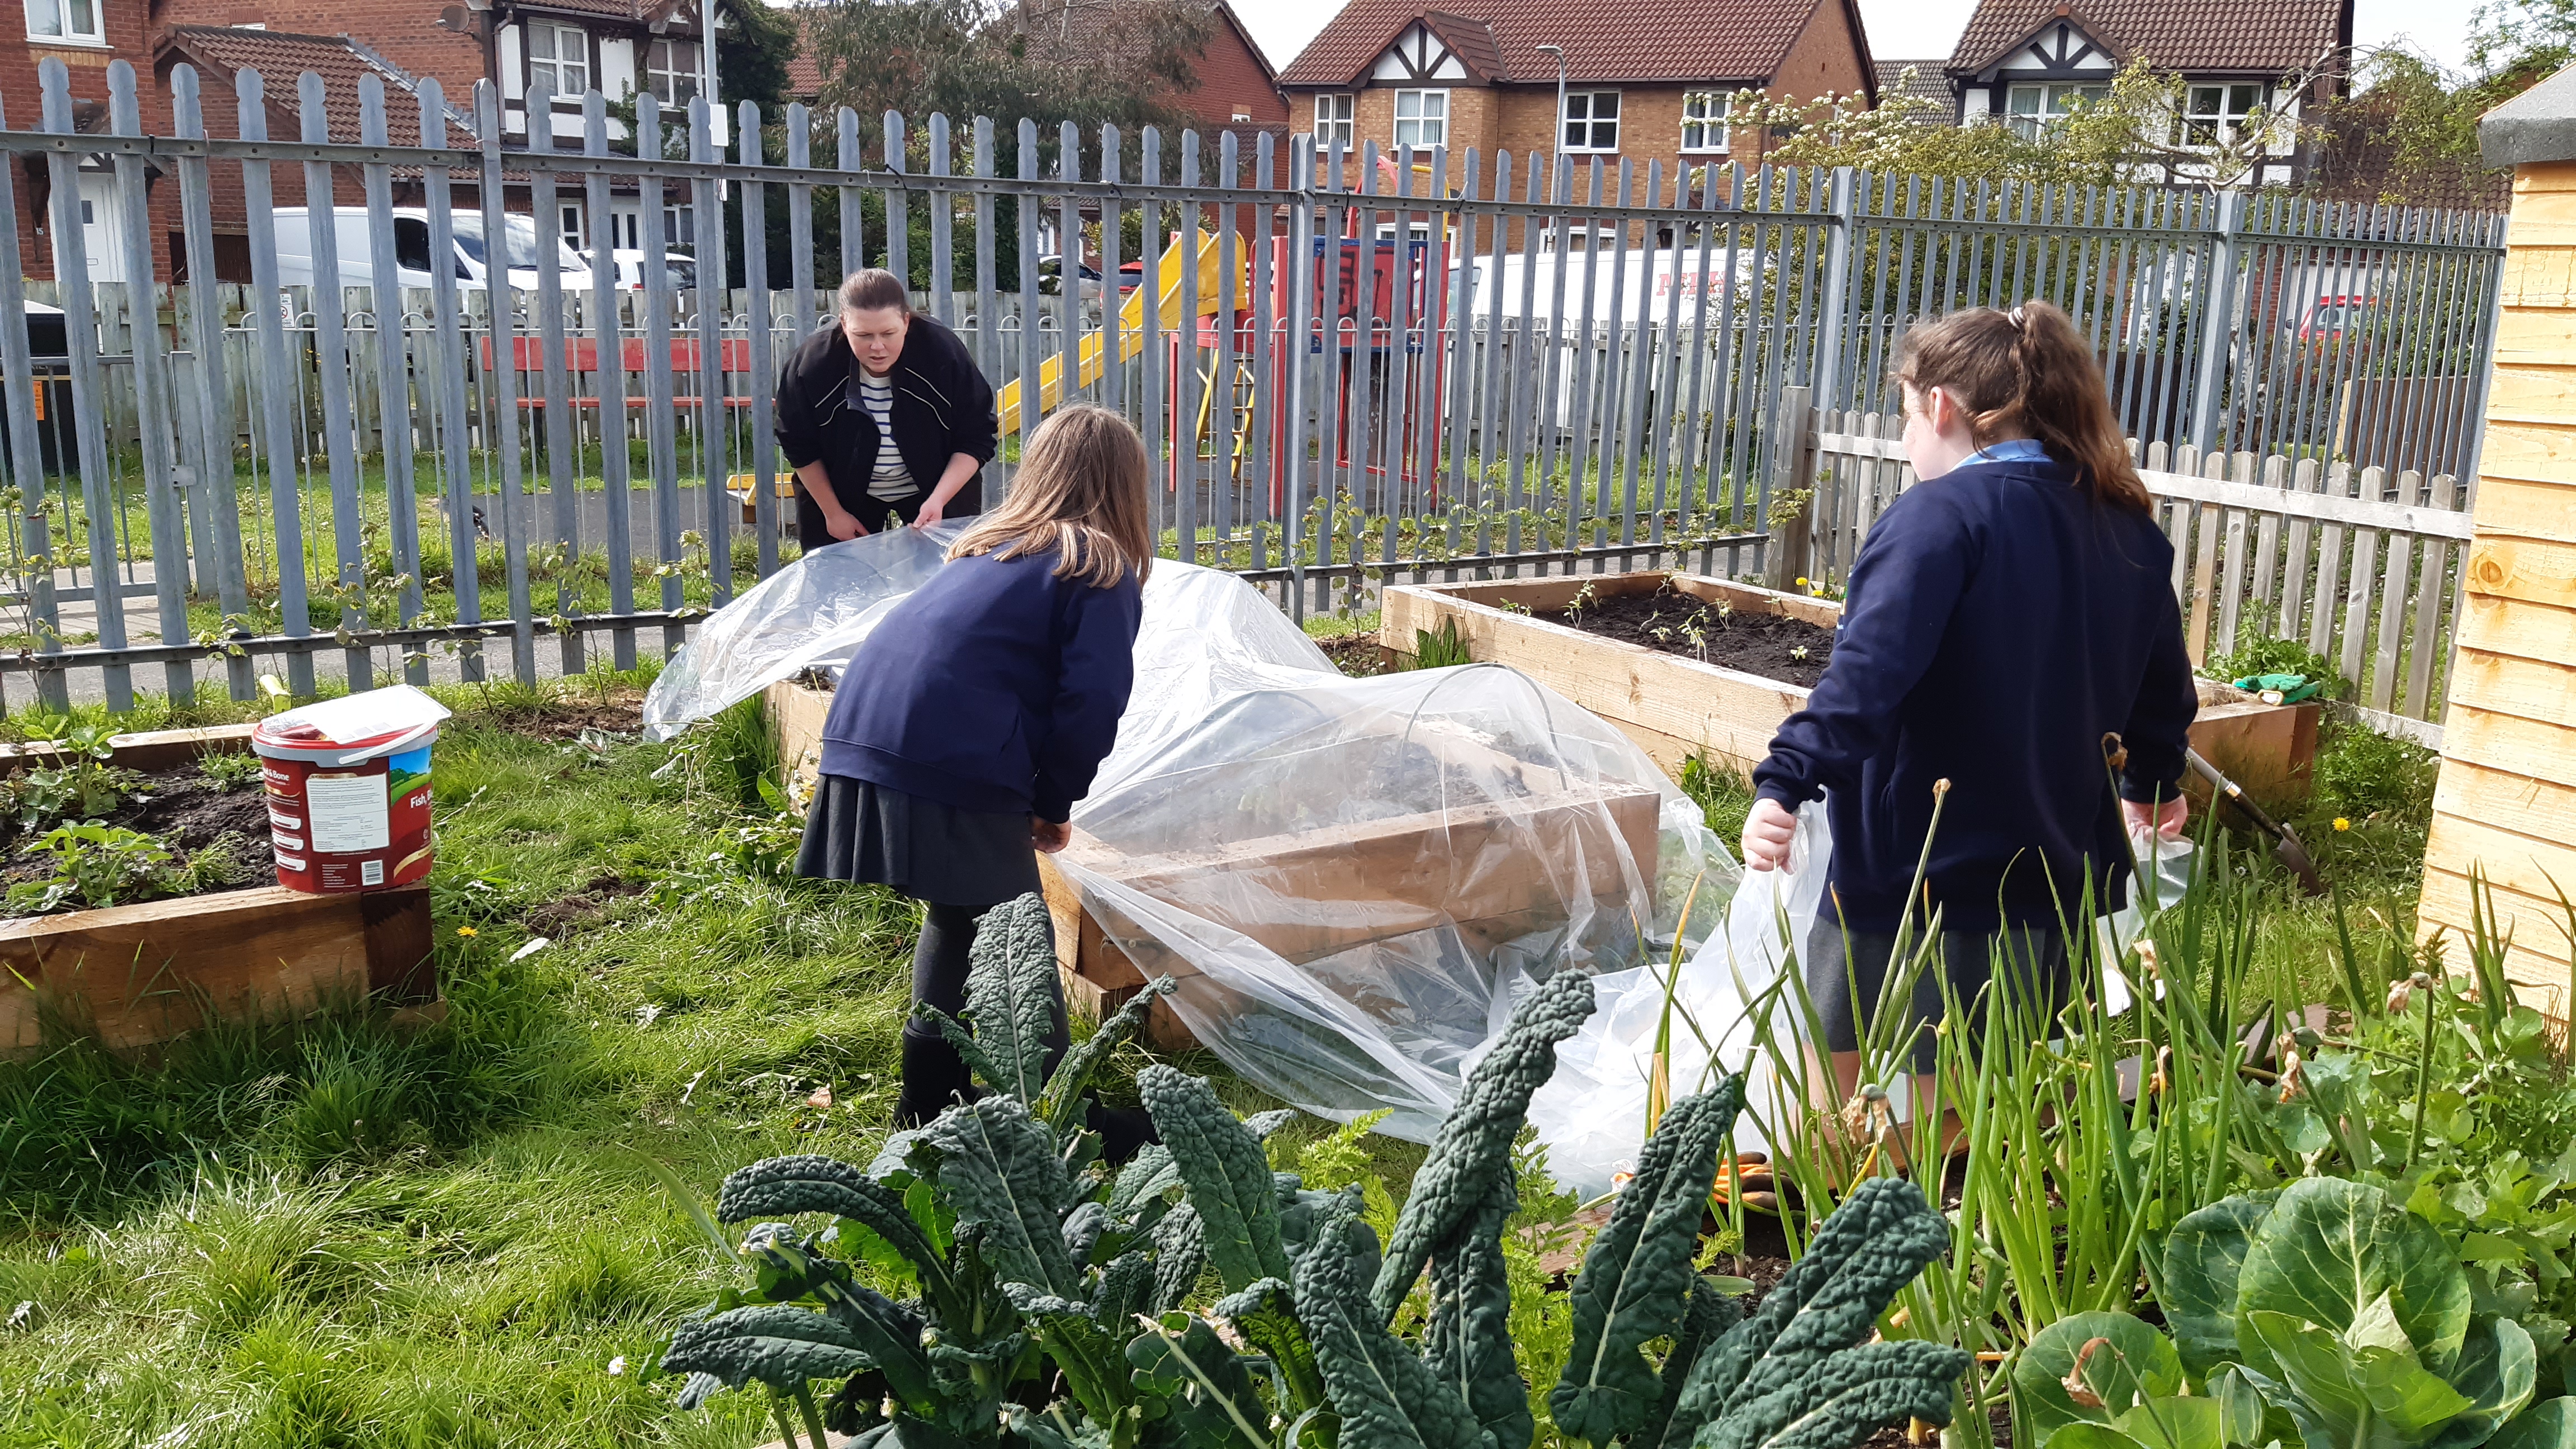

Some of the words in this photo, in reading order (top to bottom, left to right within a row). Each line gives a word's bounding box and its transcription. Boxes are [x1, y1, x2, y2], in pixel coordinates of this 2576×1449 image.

[36, 227, 44, 235] 15
[272, 770, 290, 781] Bone
[410, 793, 427, 808] Fish,
